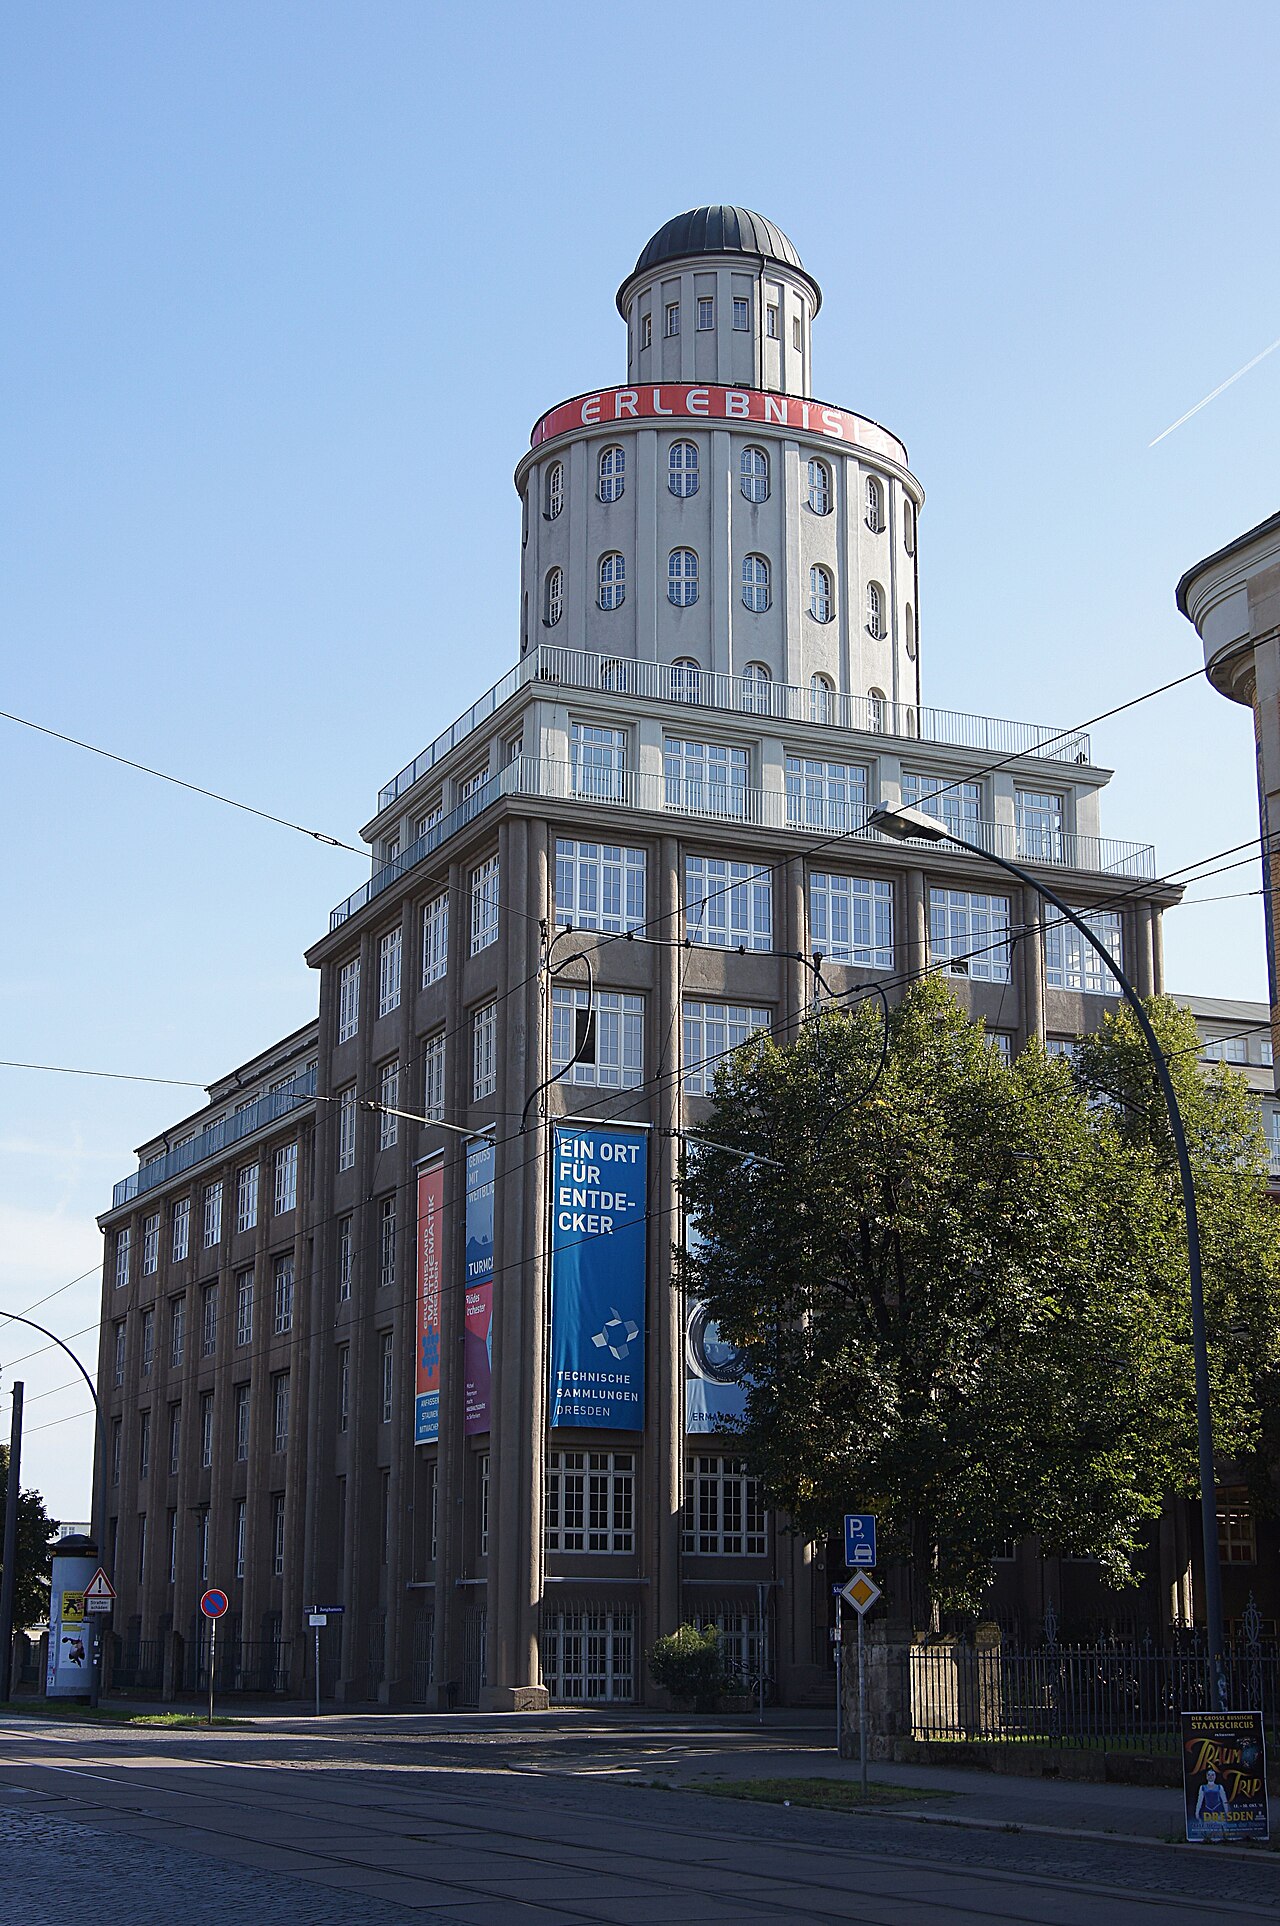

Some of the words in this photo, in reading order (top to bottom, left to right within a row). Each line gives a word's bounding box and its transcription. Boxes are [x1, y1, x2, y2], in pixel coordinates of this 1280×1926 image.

[560, 1138, 594, 1160] EIN
[600, 1143, 640, 1164] ORT
[560, 1160, 601, 1185] FÜR
[559, 1187, 636, 1212] ENTDE-
[558, 1212, 614, 1235] CKER
[427, 1194, 435, 1321] MATHEMATIK
[557, 1371, 631, 1384] TECHNISCHE
[556, 1388, 638, 1402] SAMMLUNGEN
[557, 1405, 610, 1416] DRESDEN
[849, 1518, 863, 1539] P
[1191, 1721, 1254, 1729] STAATSCIRCUS
[1203, 1811, 1254, 1822] DRESDEN
